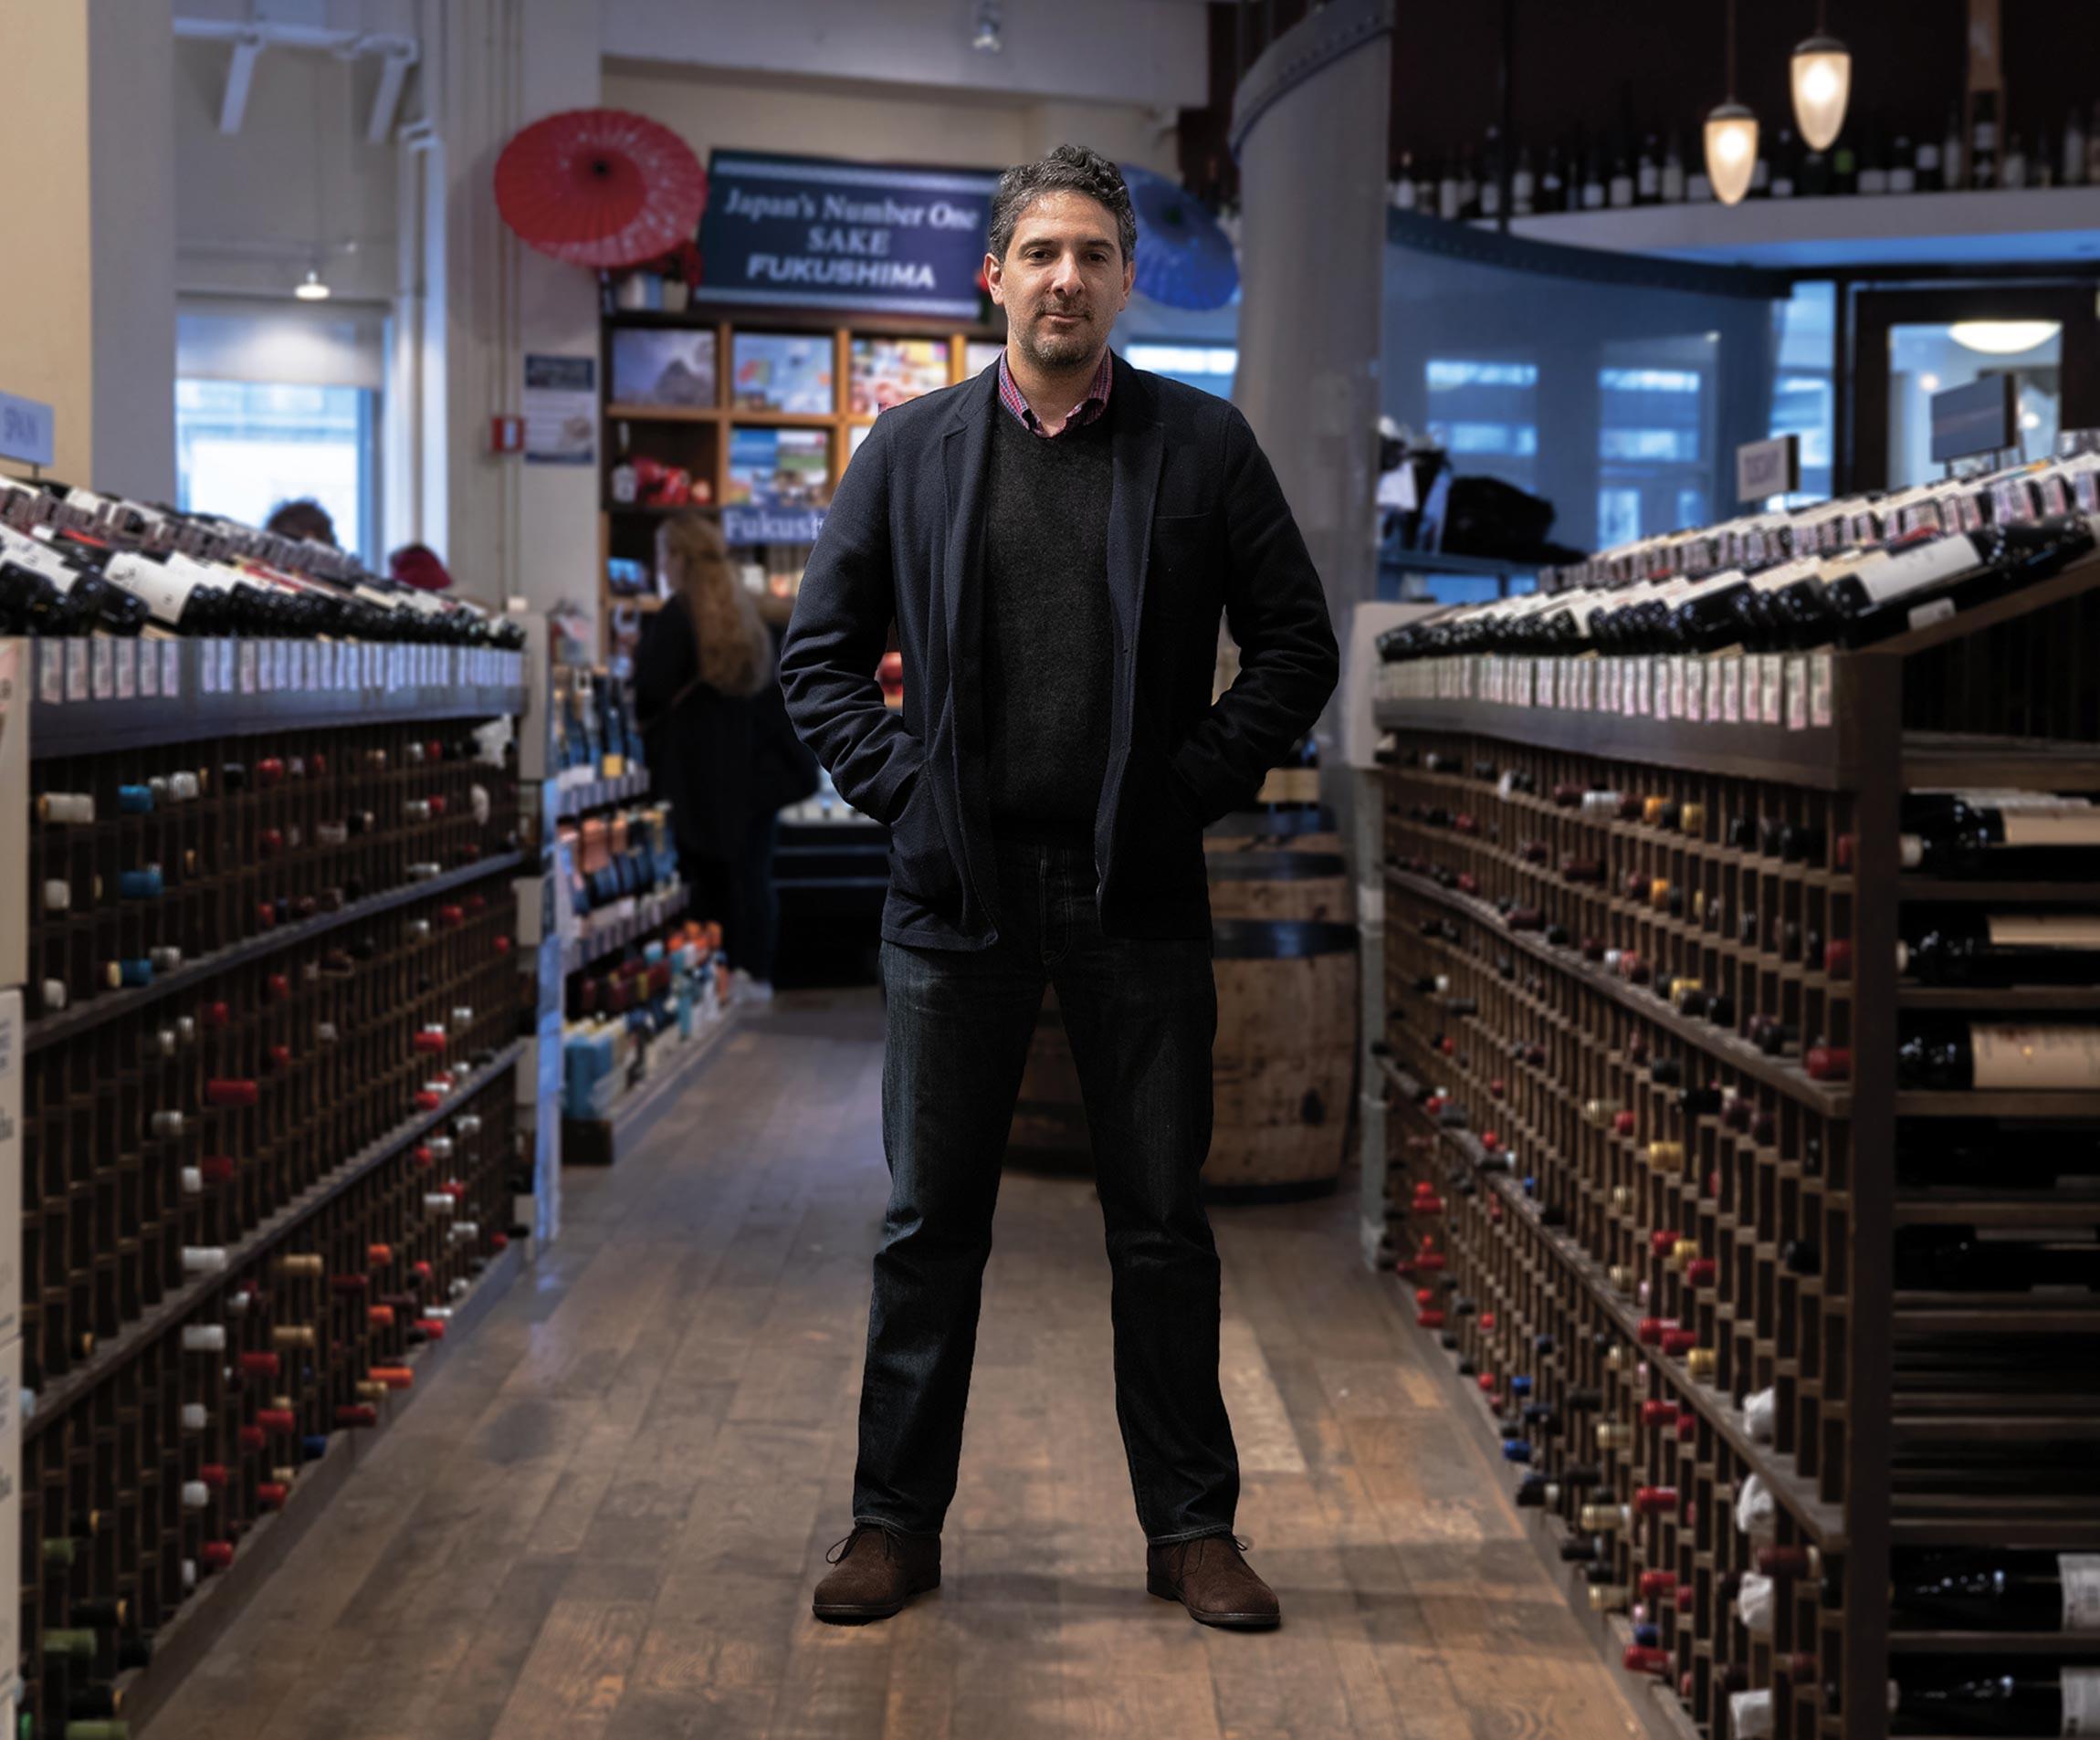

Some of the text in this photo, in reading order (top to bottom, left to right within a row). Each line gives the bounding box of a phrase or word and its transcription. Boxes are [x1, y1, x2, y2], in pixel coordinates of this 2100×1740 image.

[724, 187, 979, 231] Japan's Number One
[807, 226, 890, 257] SAKE
[747, 253, 936, 290] FUKUSHIMA
